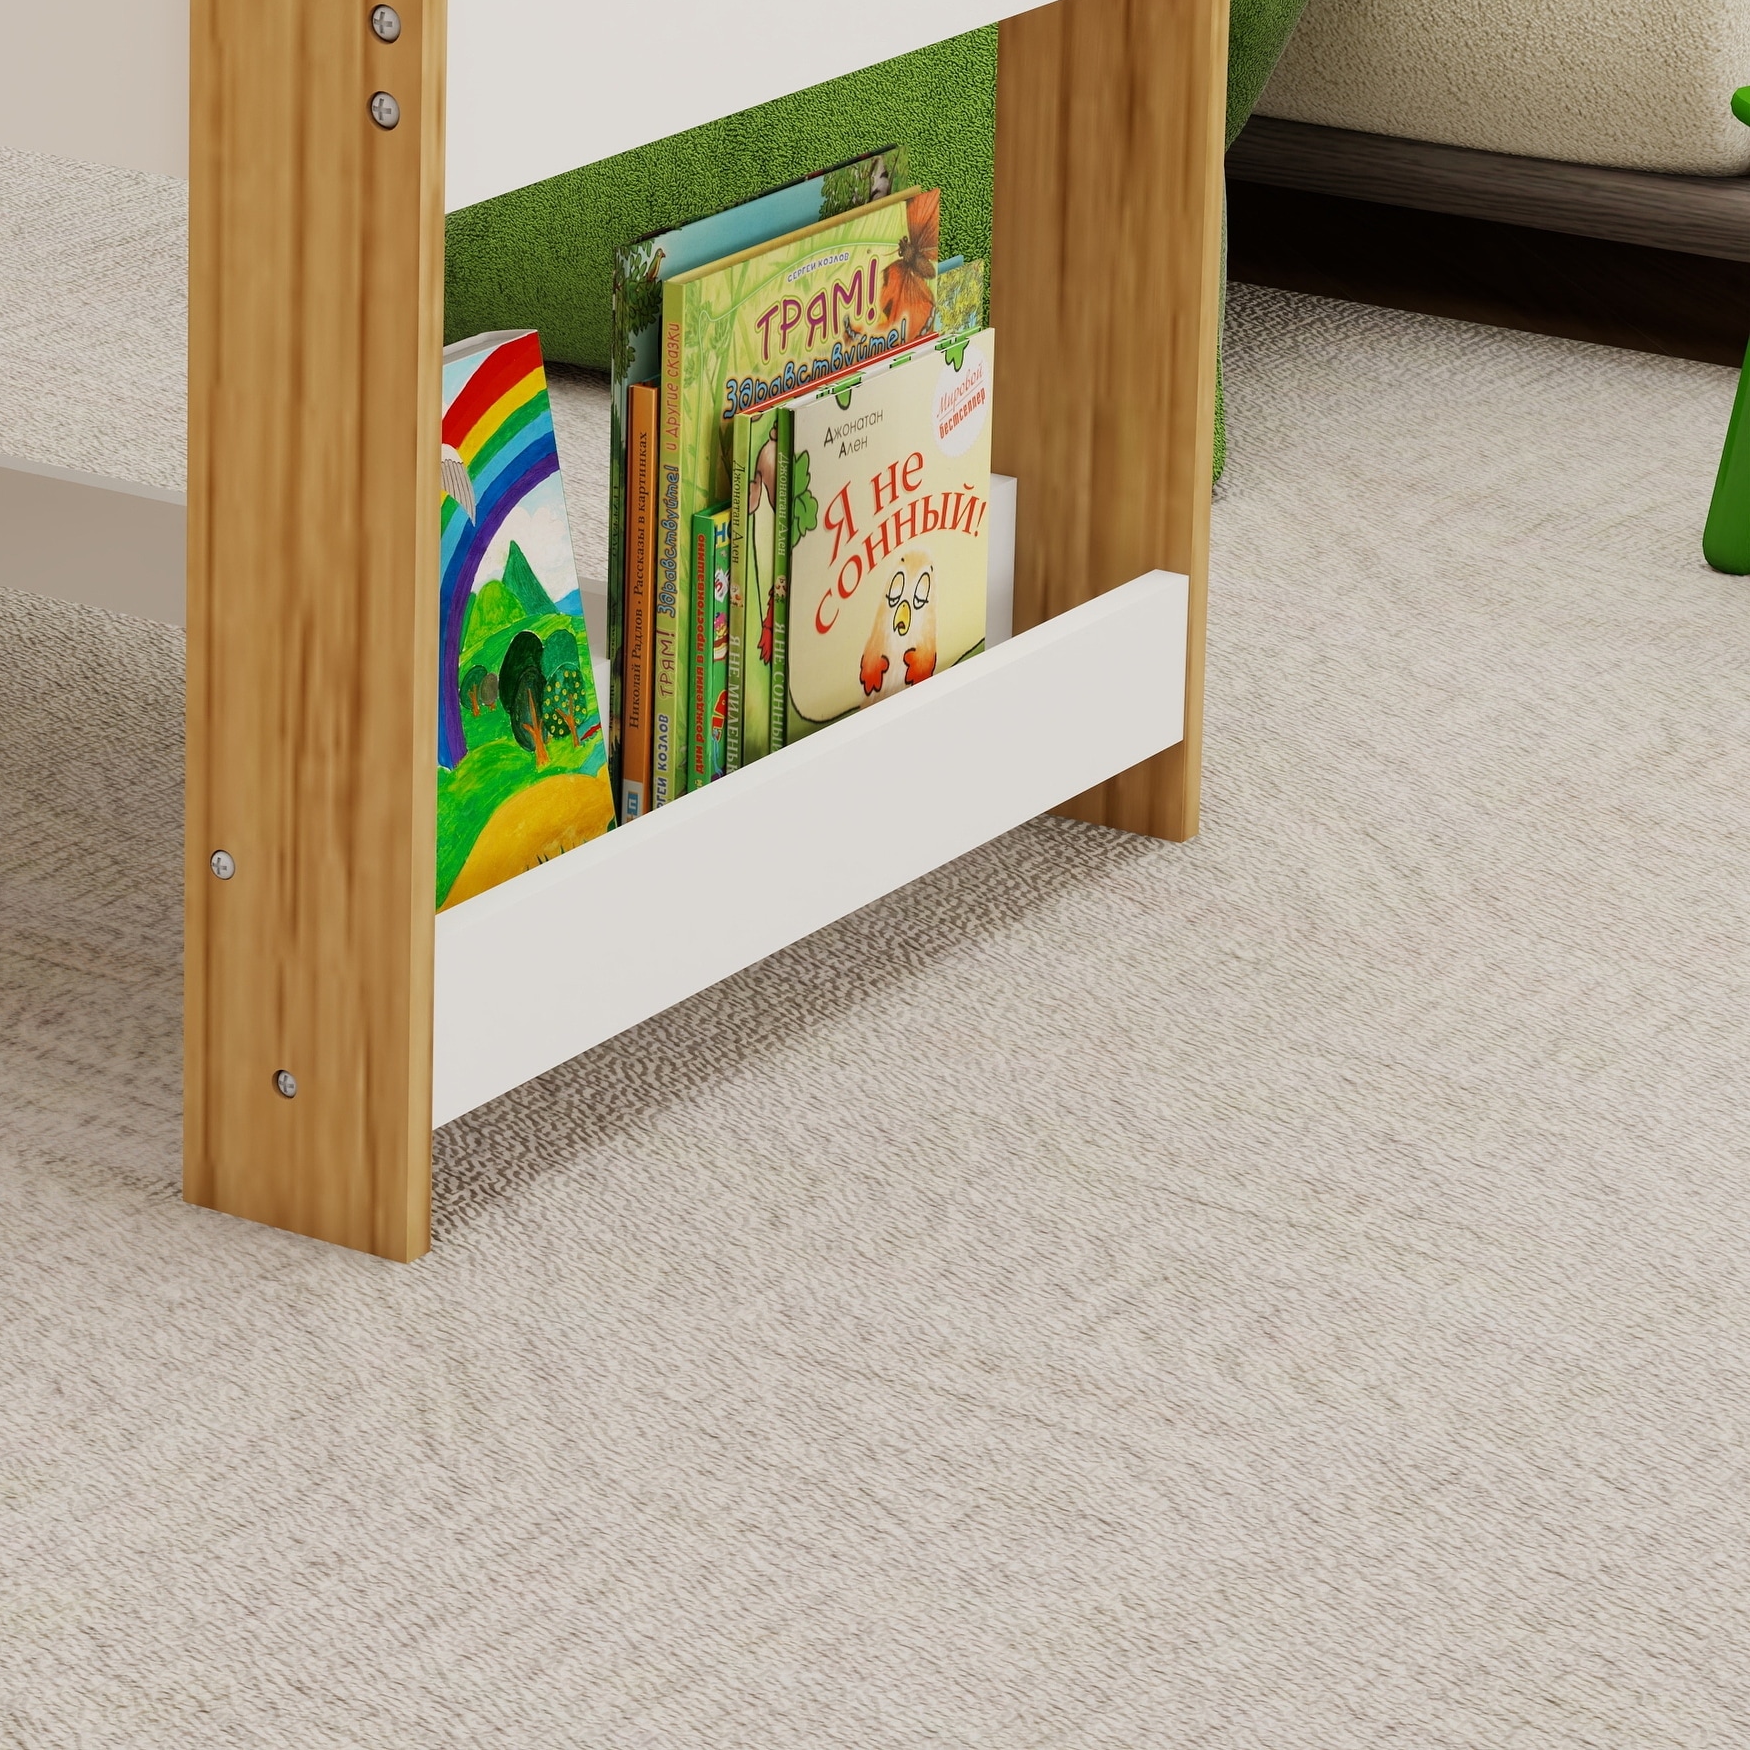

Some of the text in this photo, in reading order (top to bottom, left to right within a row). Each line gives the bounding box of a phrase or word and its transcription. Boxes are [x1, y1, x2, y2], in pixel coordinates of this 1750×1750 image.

[823, 409, 883, 446] Джонатан
[838, 435, 868, 459] Ален
[638, 431, 649, 512] картинках
[777, 451, 789, 556] Джонатан Ален
[732, 460, 745, 564] Джонатан Ален
[824, 480, 859, 569] Я
[633, 529, 646, 597] Рассказы
[631, 608, 643, 660] Радлов
[629, 665, 642, 729] Николай
[658, 714, 669, 772] КОЗЛОВ
